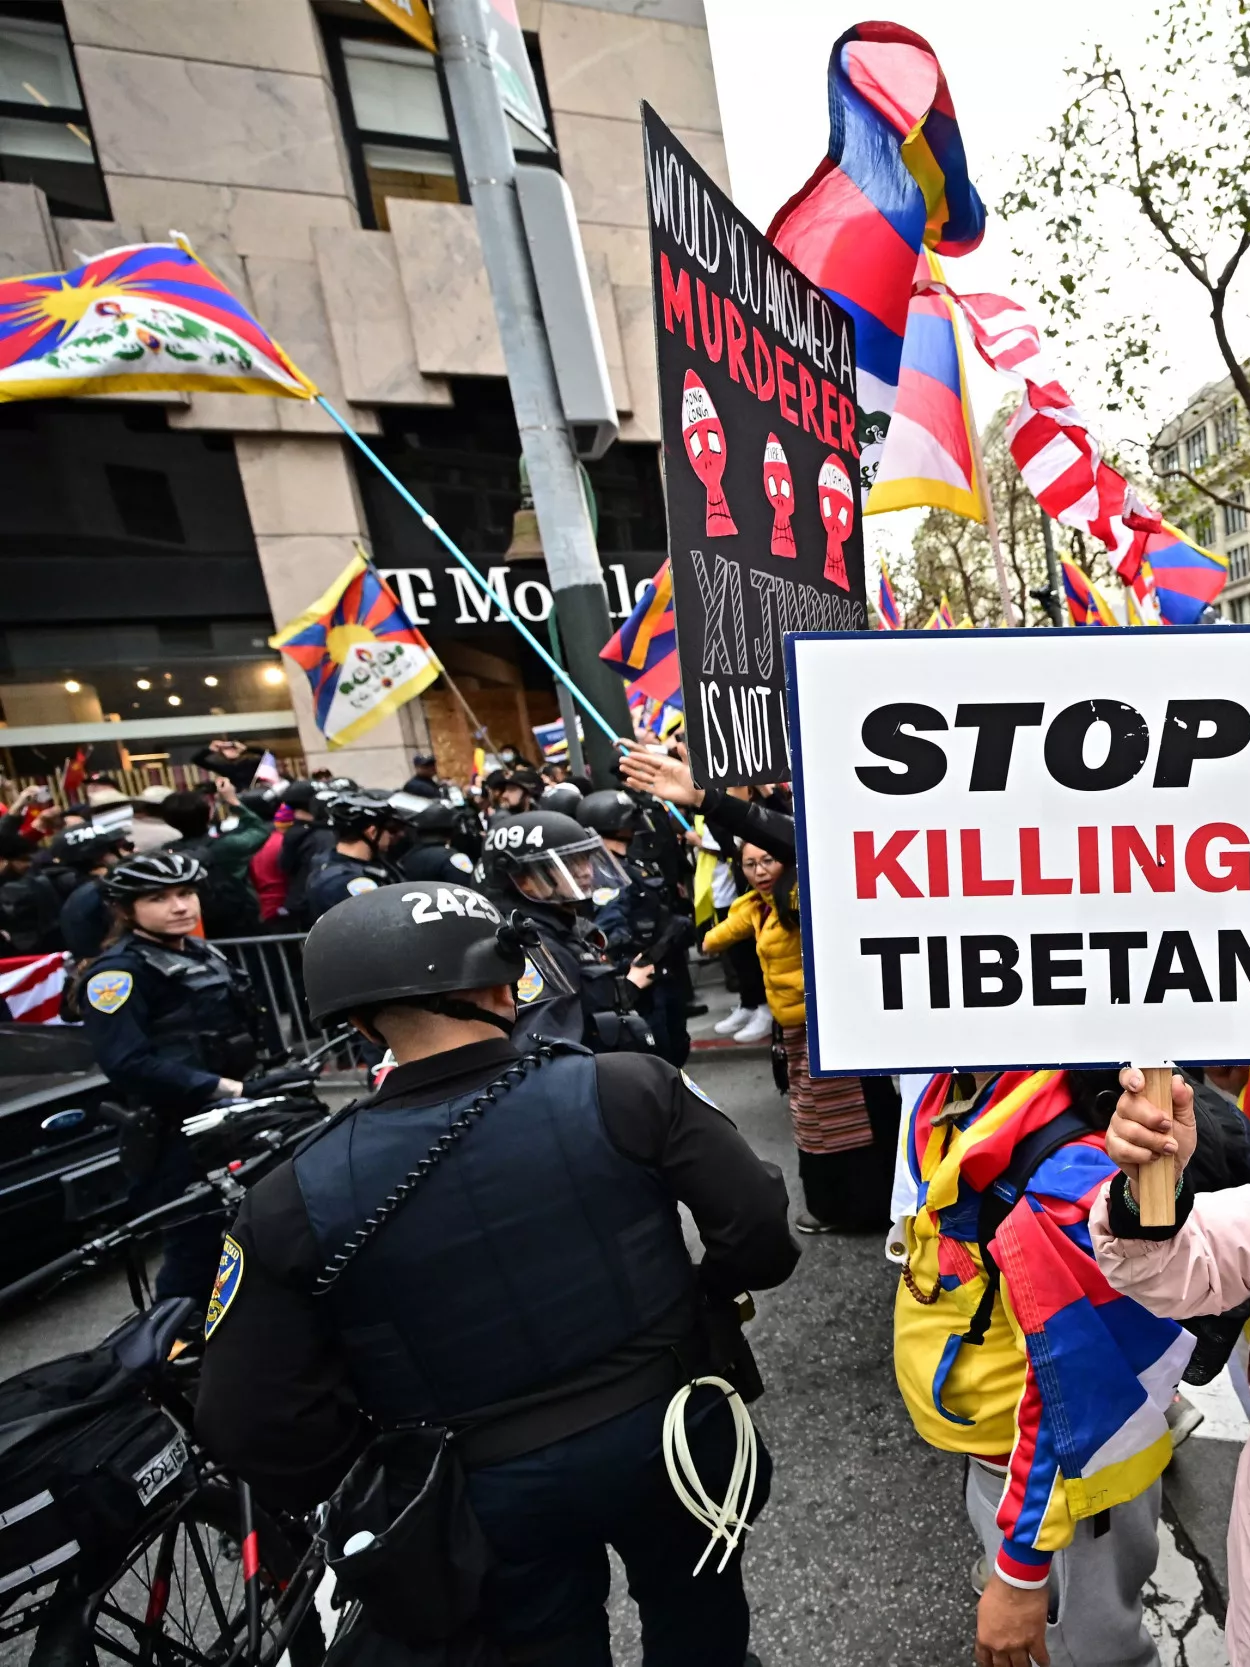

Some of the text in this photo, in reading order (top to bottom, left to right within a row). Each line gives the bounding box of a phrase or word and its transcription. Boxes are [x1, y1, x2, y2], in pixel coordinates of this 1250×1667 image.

[645, 126, 855, 395] WOULD YOU ANSWER A
[659, 250, 861, 461] MURDERER
[766, 447, 785, 461] TIBET
[700, 680, 729, 780] IS
[728, 685, 772, 778] NOT
[485, 824, 544, 851] 2094
[401, 887, 501, 925] 2425
